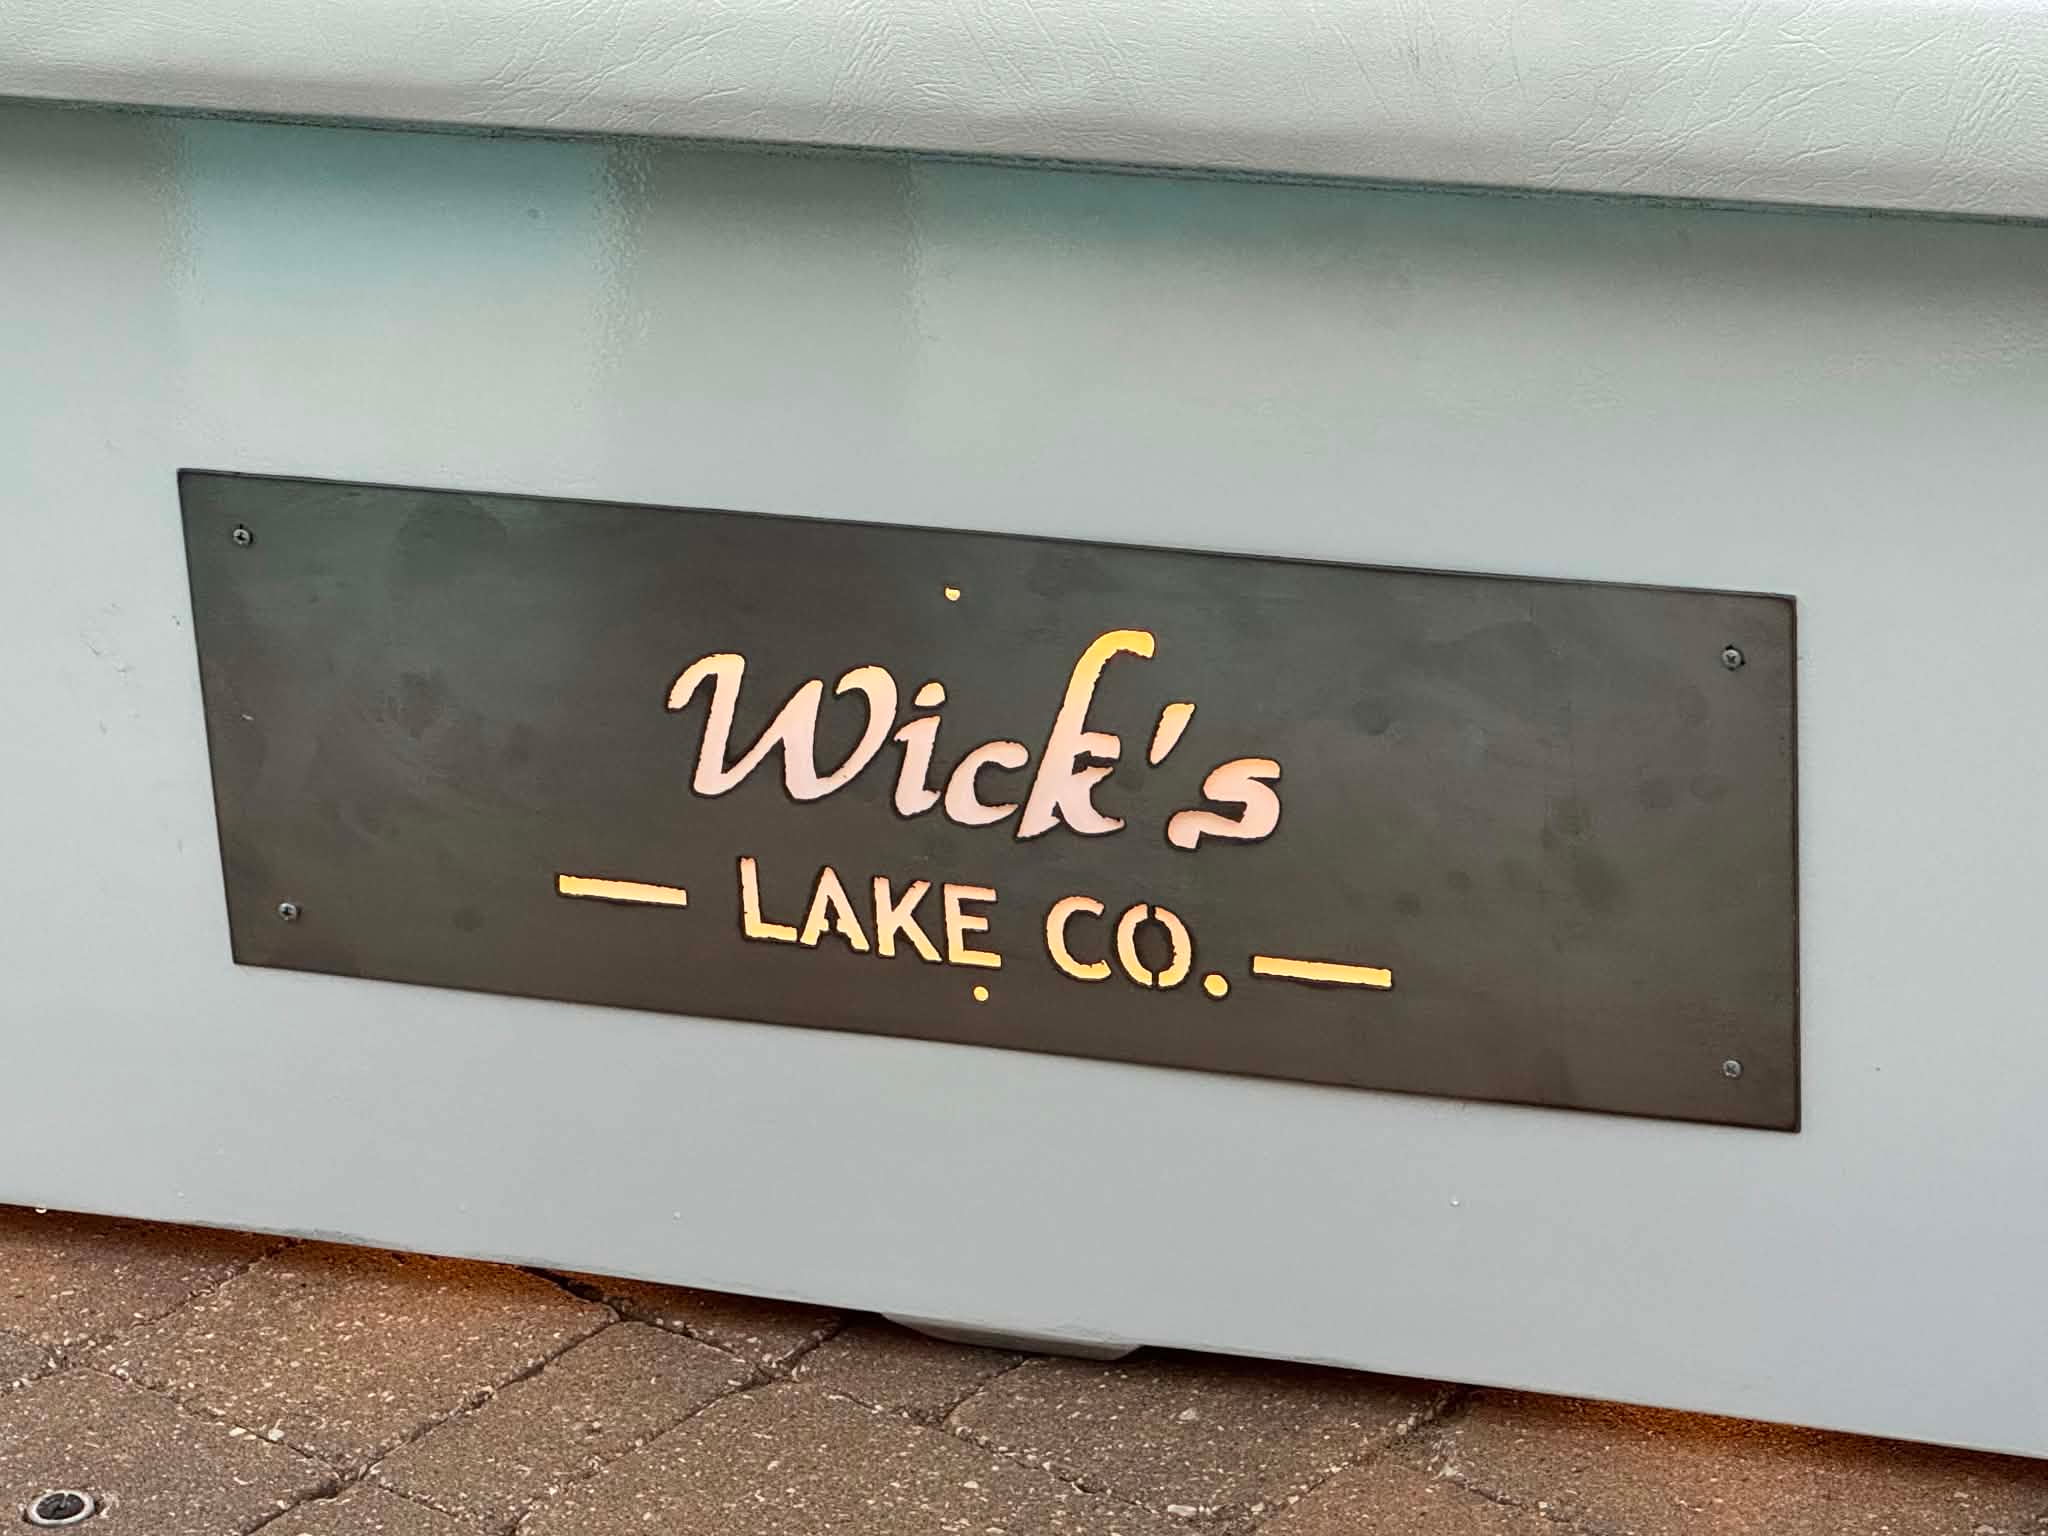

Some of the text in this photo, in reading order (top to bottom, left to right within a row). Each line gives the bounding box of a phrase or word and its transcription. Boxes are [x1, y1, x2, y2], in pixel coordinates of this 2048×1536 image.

[666, 629, 1282, 850] Wick's
[739, 857, 1229, 998] LAKE CO.
